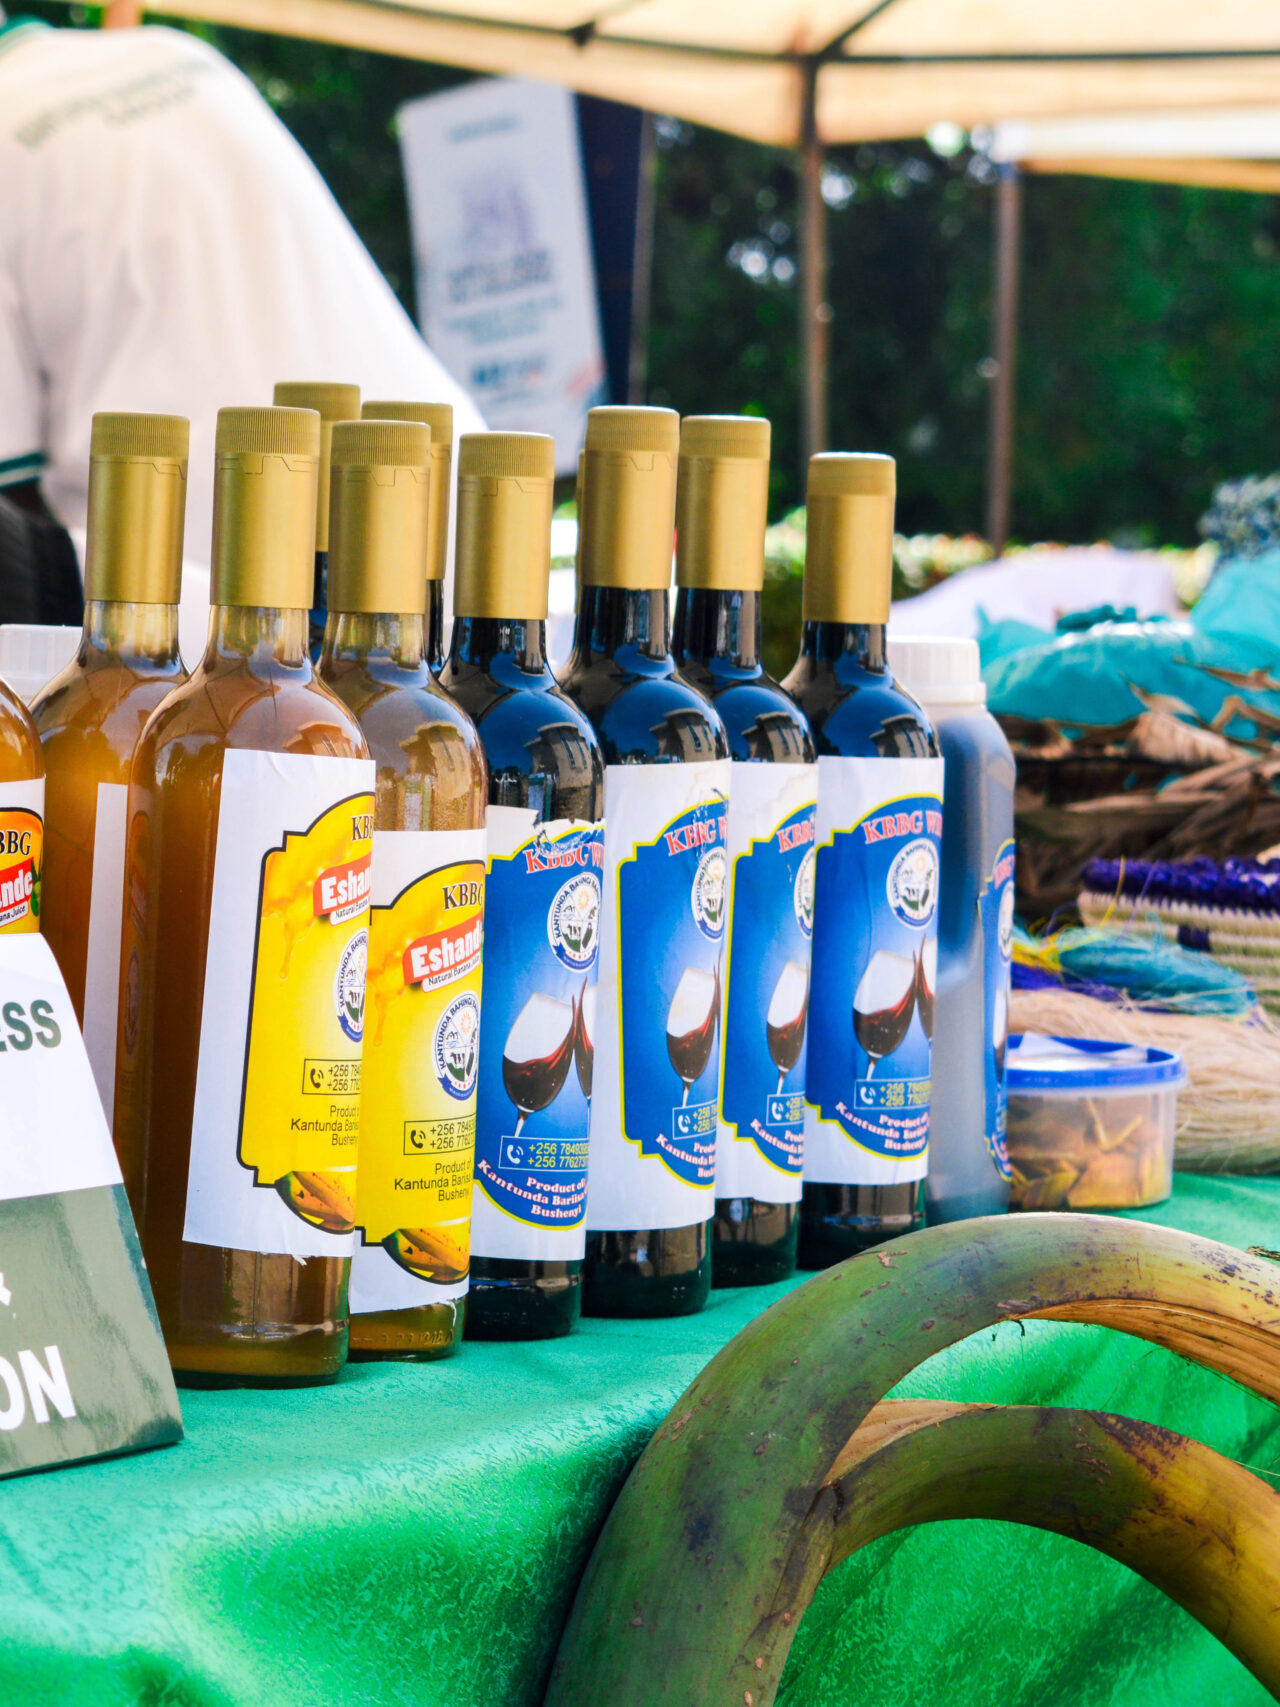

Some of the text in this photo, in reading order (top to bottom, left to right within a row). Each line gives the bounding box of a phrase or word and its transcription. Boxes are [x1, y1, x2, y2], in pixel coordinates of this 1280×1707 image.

[861, 810, 923, 845] KBBG
[11, 904, 26, 918] Juice
[410, 919, 483, 979] Eshand
[328, 1064, 349, 1077] +256
[327, 1078, 349, 1091] +256
[291, 1117, 343, 1131] Kantunda
[430, 1124, 454, 1136] +256
[429, 1137, 454, 1150] +256
[528, 1142, 558, 1155] +256
[656, 1133, 708, 1166] Kantunda
[435, 1159, 466, 1175] Product
[528, 1155, 557, 1168] +256
[394, 1176, 449, 1191] Kantunda
[477, 1159, 550, 1205] Kantunda
[526, 1176, 576, 1194] Product
[531, 1203, 583, 1219] Bushenyi
